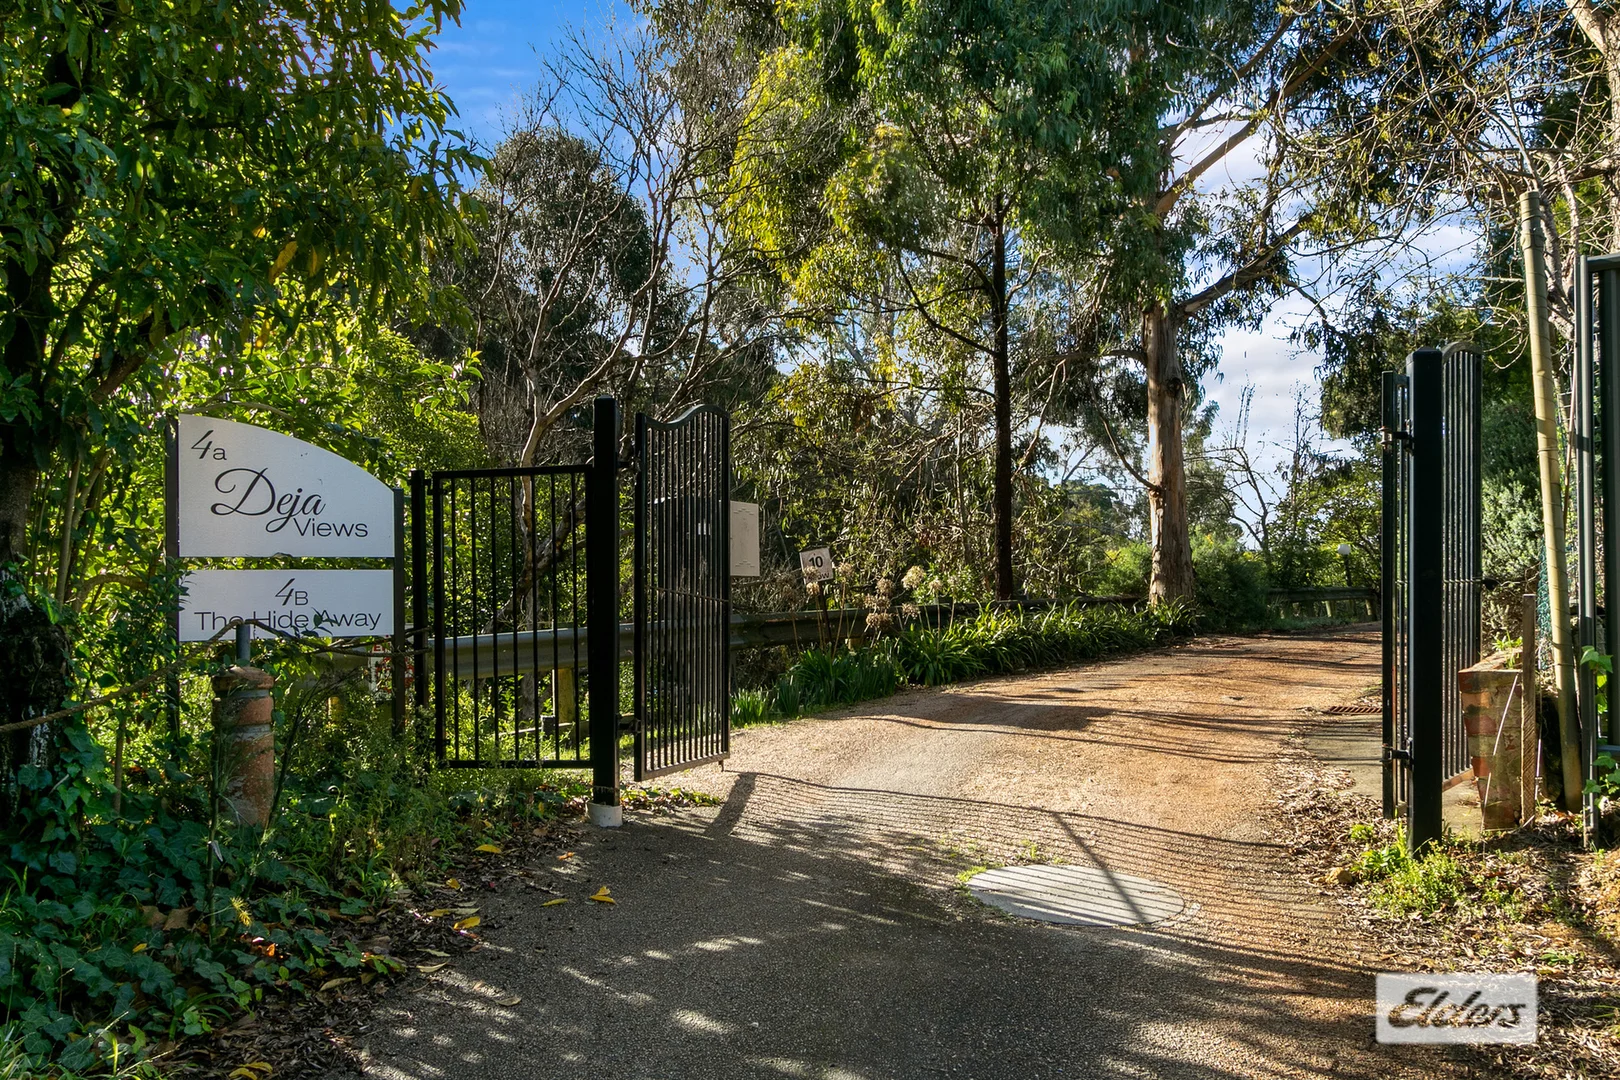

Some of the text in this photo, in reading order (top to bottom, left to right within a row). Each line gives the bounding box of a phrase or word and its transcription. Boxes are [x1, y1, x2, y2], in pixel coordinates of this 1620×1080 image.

[191, 429, 227, 460] 4a
[210, 467, 326, 533] Deja
[293, 518, 369, 537] Views
[809, 555, 824, 568] 10
[275, 578, 309, 606] 4B
[253, 610, 309, 629] Hide
